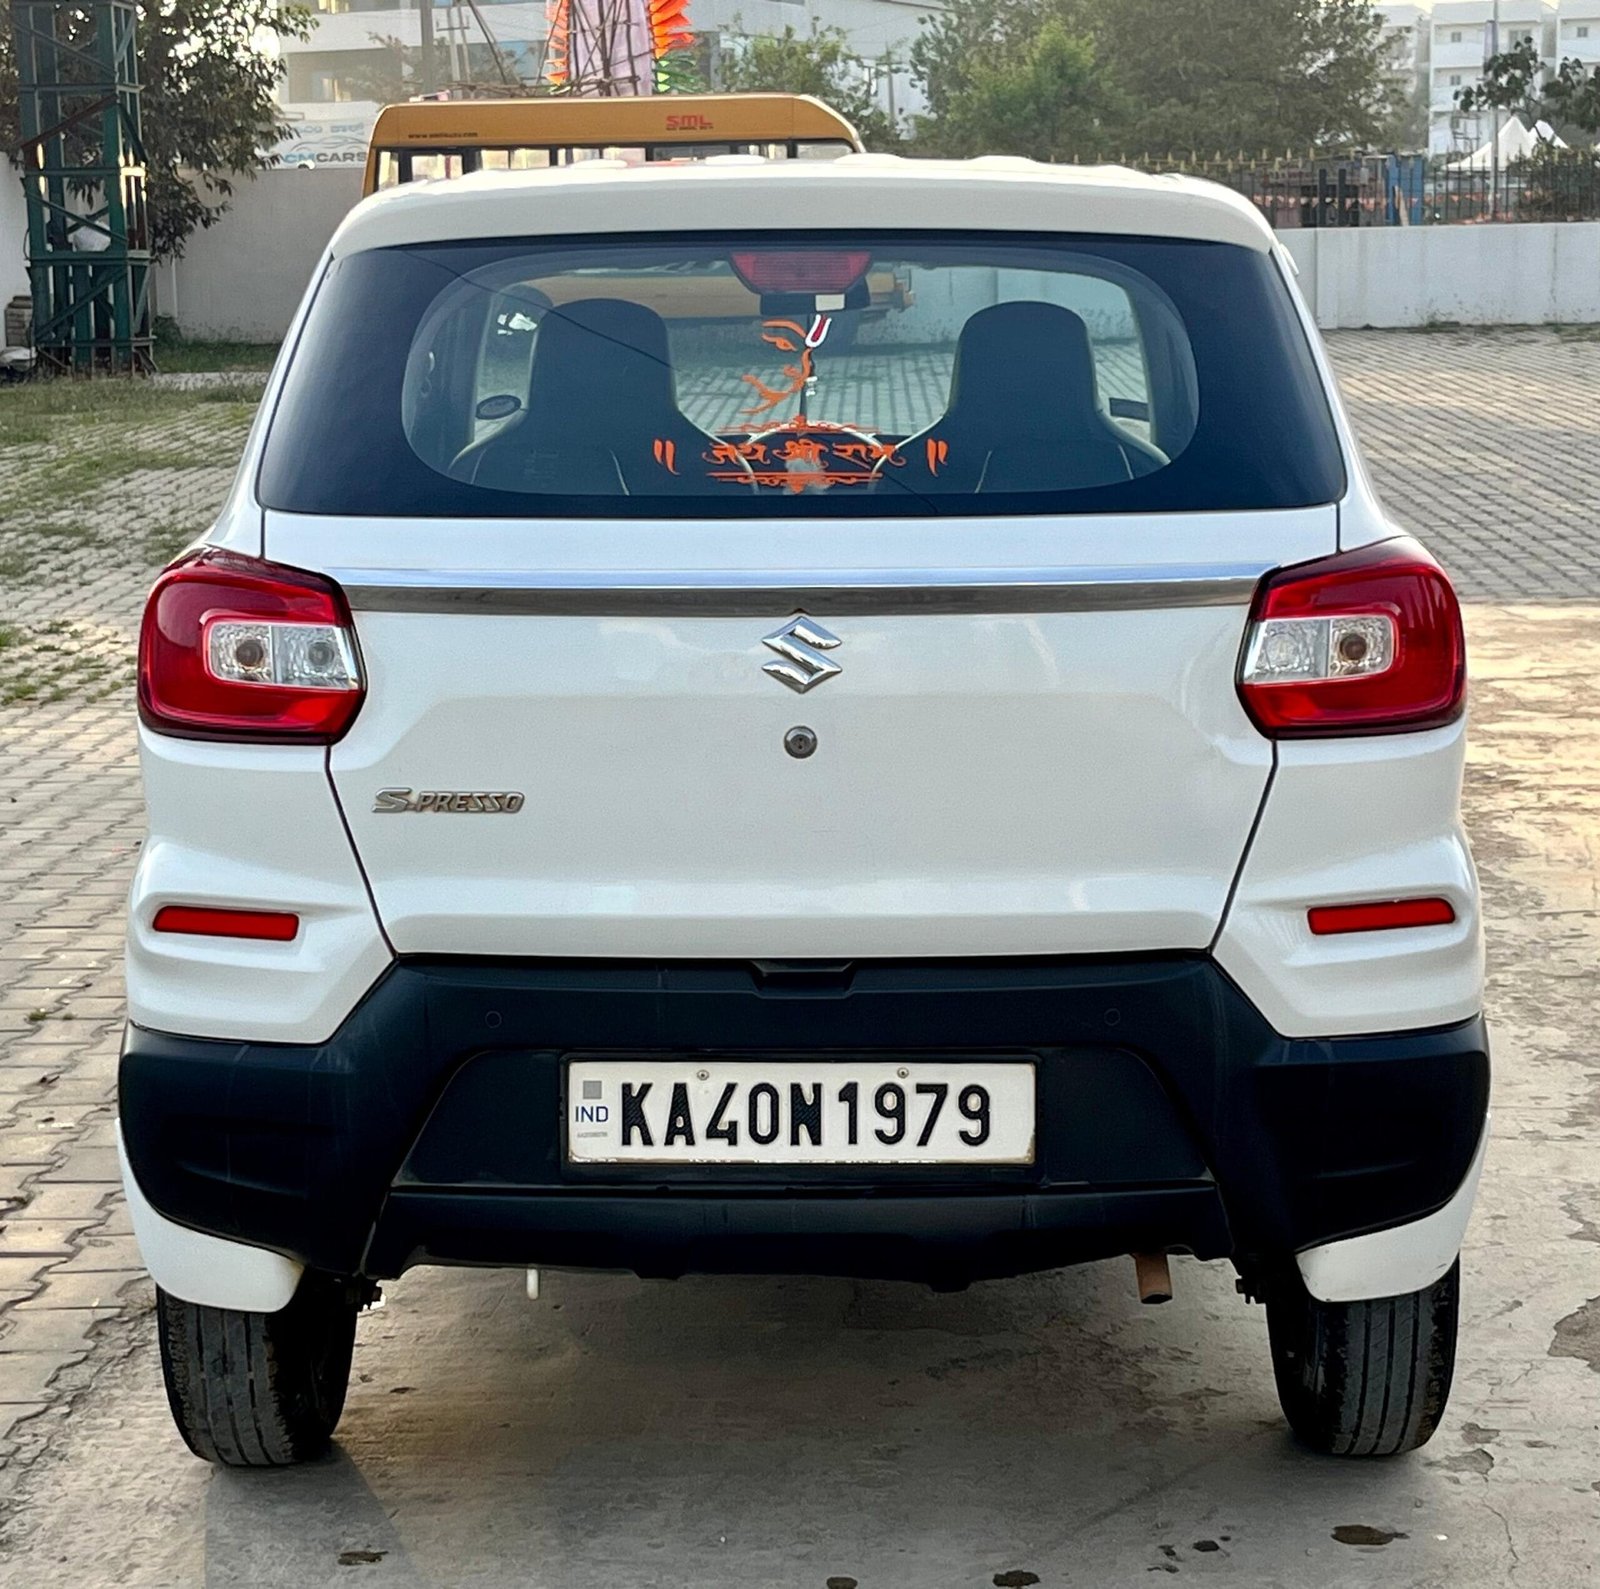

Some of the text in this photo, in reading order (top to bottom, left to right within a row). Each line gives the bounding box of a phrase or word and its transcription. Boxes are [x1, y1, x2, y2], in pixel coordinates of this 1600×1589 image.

[665, 114, 713, 127] SML
[702, 442, 771, 465] जय
[772, 438, 830, 469] श्री
[831, 442, 907, 471] राम
[575, 1105, 609, 1123] IND
[621, 1081, 991, 1147] KA40N1979
